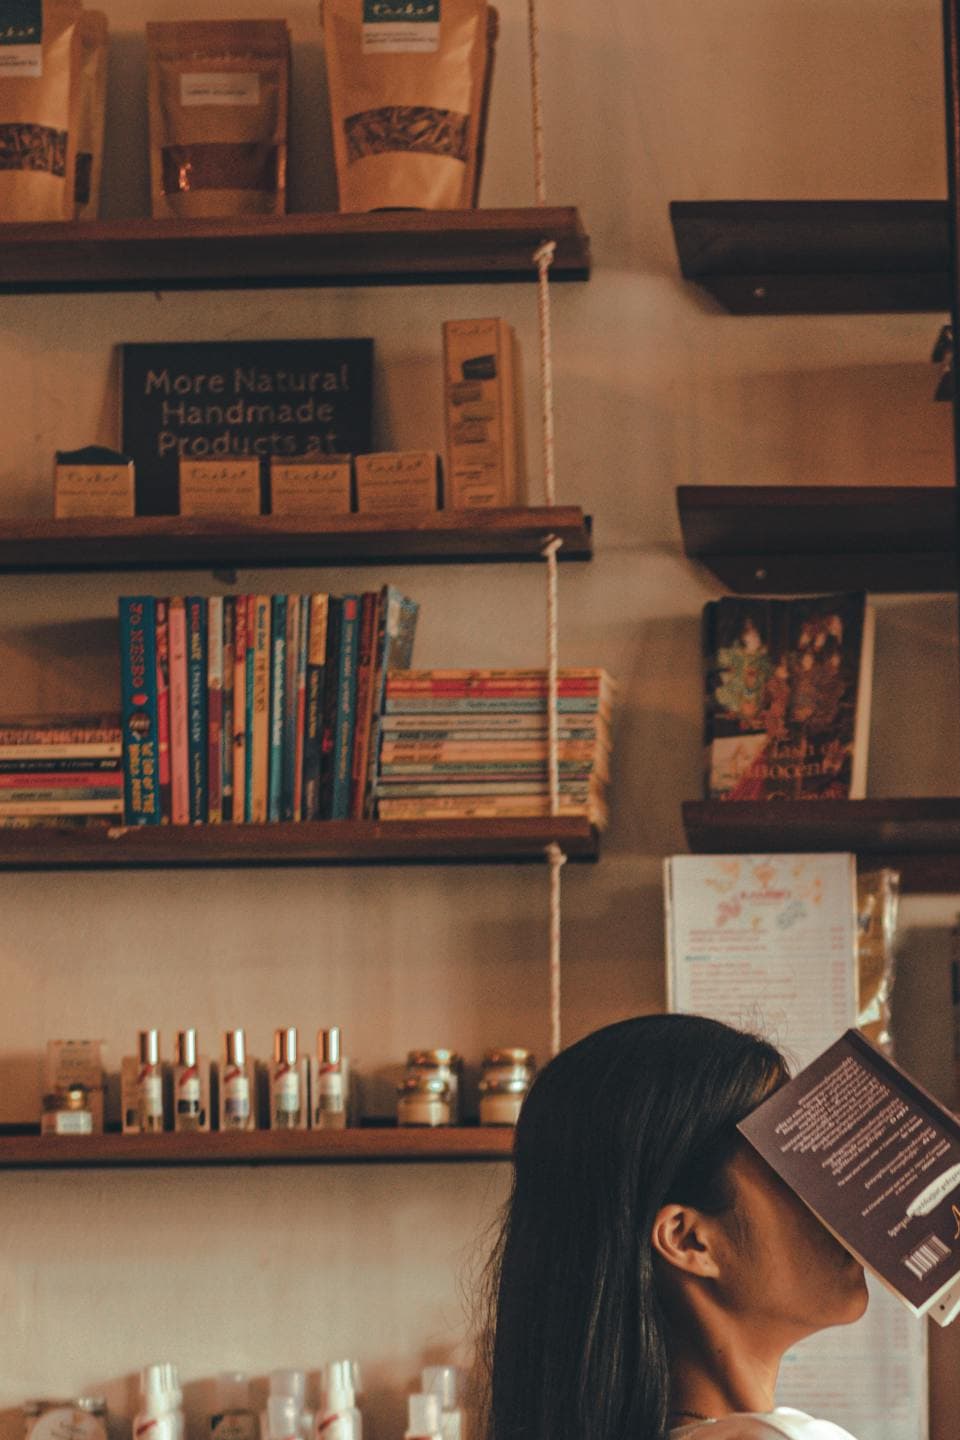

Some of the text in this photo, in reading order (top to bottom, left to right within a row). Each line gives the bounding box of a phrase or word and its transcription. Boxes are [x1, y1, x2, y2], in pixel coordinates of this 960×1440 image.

[145, 362, 351, 396] More Natural
[161, 397, 335, 427] Handmade
[158, 431, 337, 458] Products at
